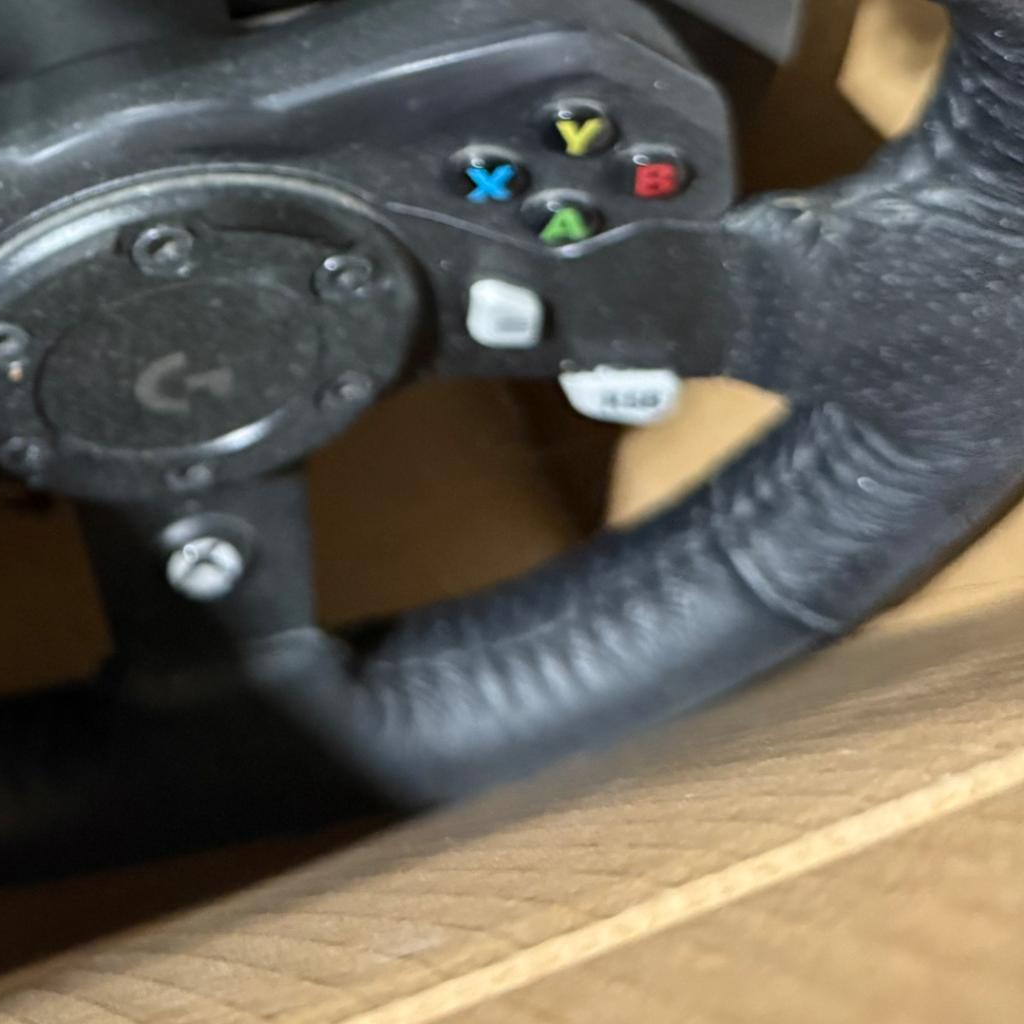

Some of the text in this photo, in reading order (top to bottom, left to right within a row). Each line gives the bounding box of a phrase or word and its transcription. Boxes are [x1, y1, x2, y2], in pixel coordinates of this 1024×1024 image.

[555, 118, 603, 156] Y
[465, 164, 515, 203] X
[634, 162, 677, 199] B
[538, 207, 591, 244] A
